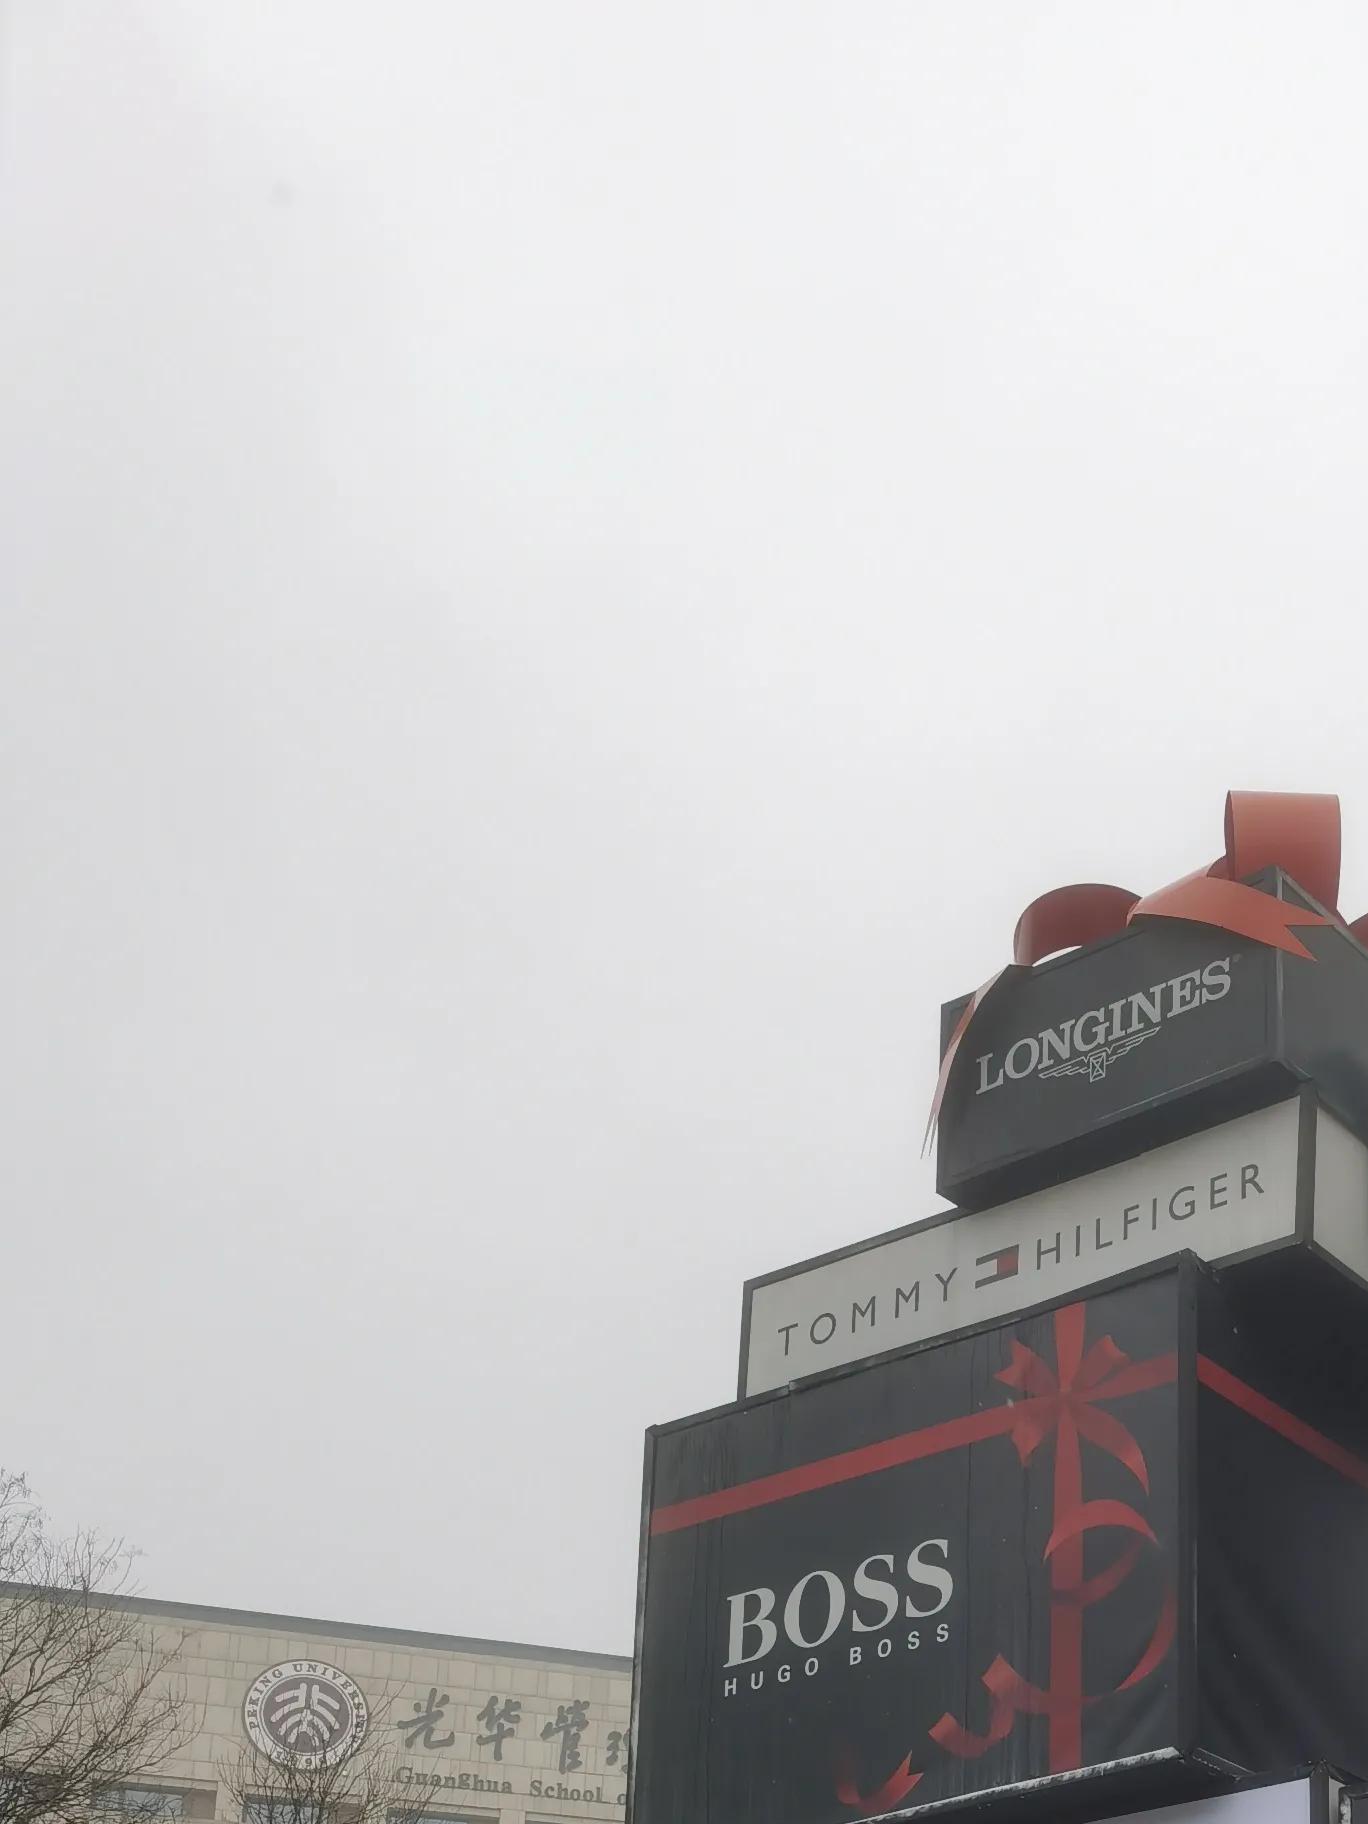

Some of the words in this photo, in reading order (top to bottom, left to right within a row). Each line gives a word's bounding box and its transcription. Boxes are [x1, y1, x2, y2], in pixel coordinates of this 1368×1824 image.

[975, 956, 1232, 1095] LONGINES
[777, 1268, 959, 1356] TOMMY
[1036, 1163, 1264, 1271] HILFIGER
[723, 1538, 954, 1668] BOSS
[724, 1657, 820, 1698] HUGO
[848, 1623, 951, 1666] BOSS
[397, 1766, 513, 1794] Guanghua
[529, 1779, 603, 1804] School
